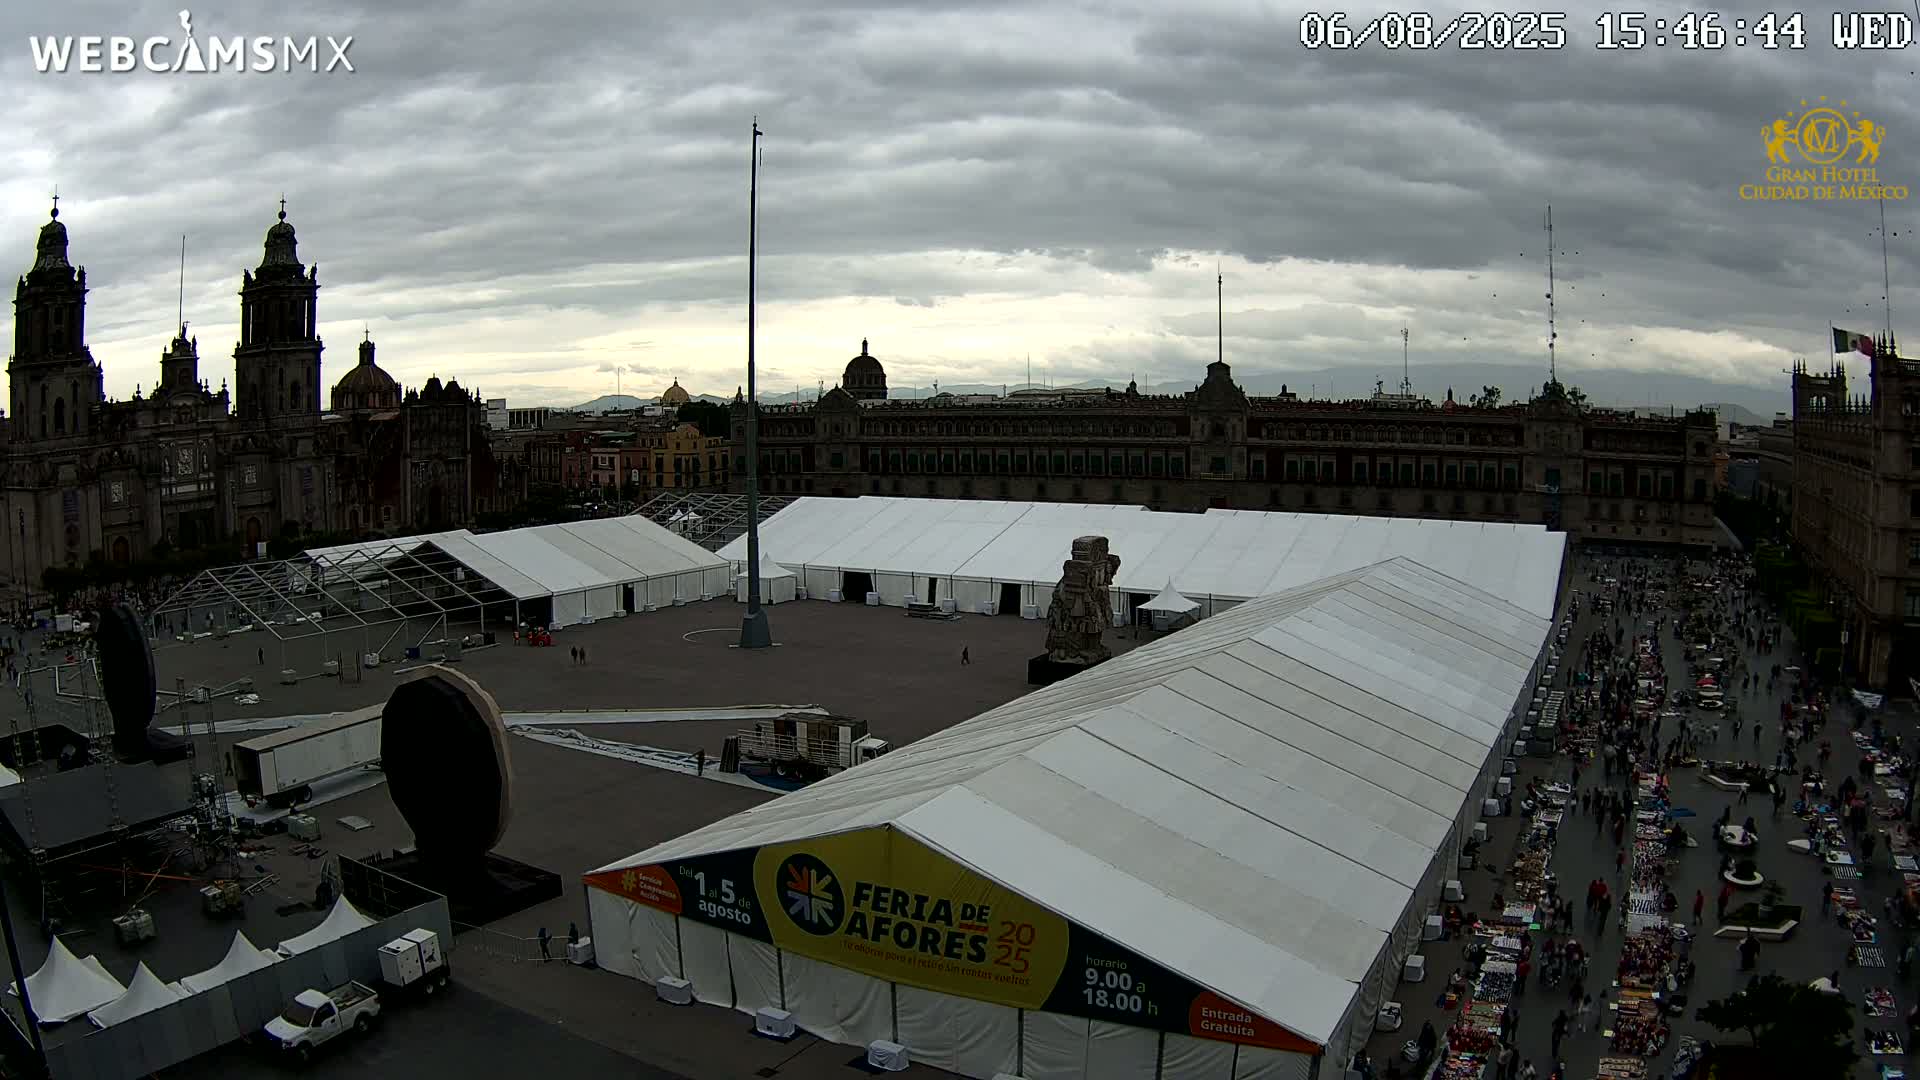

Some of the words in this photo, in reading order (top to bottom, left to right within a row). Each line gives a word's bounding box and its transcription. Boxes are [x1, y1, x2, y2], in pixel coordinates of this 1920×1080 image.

[679, 865, 693, 879] Del
[694, 871, 706, 896] 1
[709, 887, 718, 898] al
[721, 878, 736, 904] 5
[738, 895, 751, 910] de
[698, 898, 752, 925] agosto
[853, 882, 953, 926] FERIA
[960, 902, 990, 923] DE
[845, 910, 988, 963] AFORES
[998, 920, 1035, 947] 20
[994, 944, 1029, 974] 25
[1086, 954, 1127, 970] horario
[1085, 967, 1132, 991] 9.00
[1135, 981, 1146, 993] a
[1082, 987, 1142, 1013] 18.00
[1148, 999, 1159, 1016] h
[1201, 1006, 1252, 1024] Entrada
[1200, 1019, 1255, 1038] Gratuita
